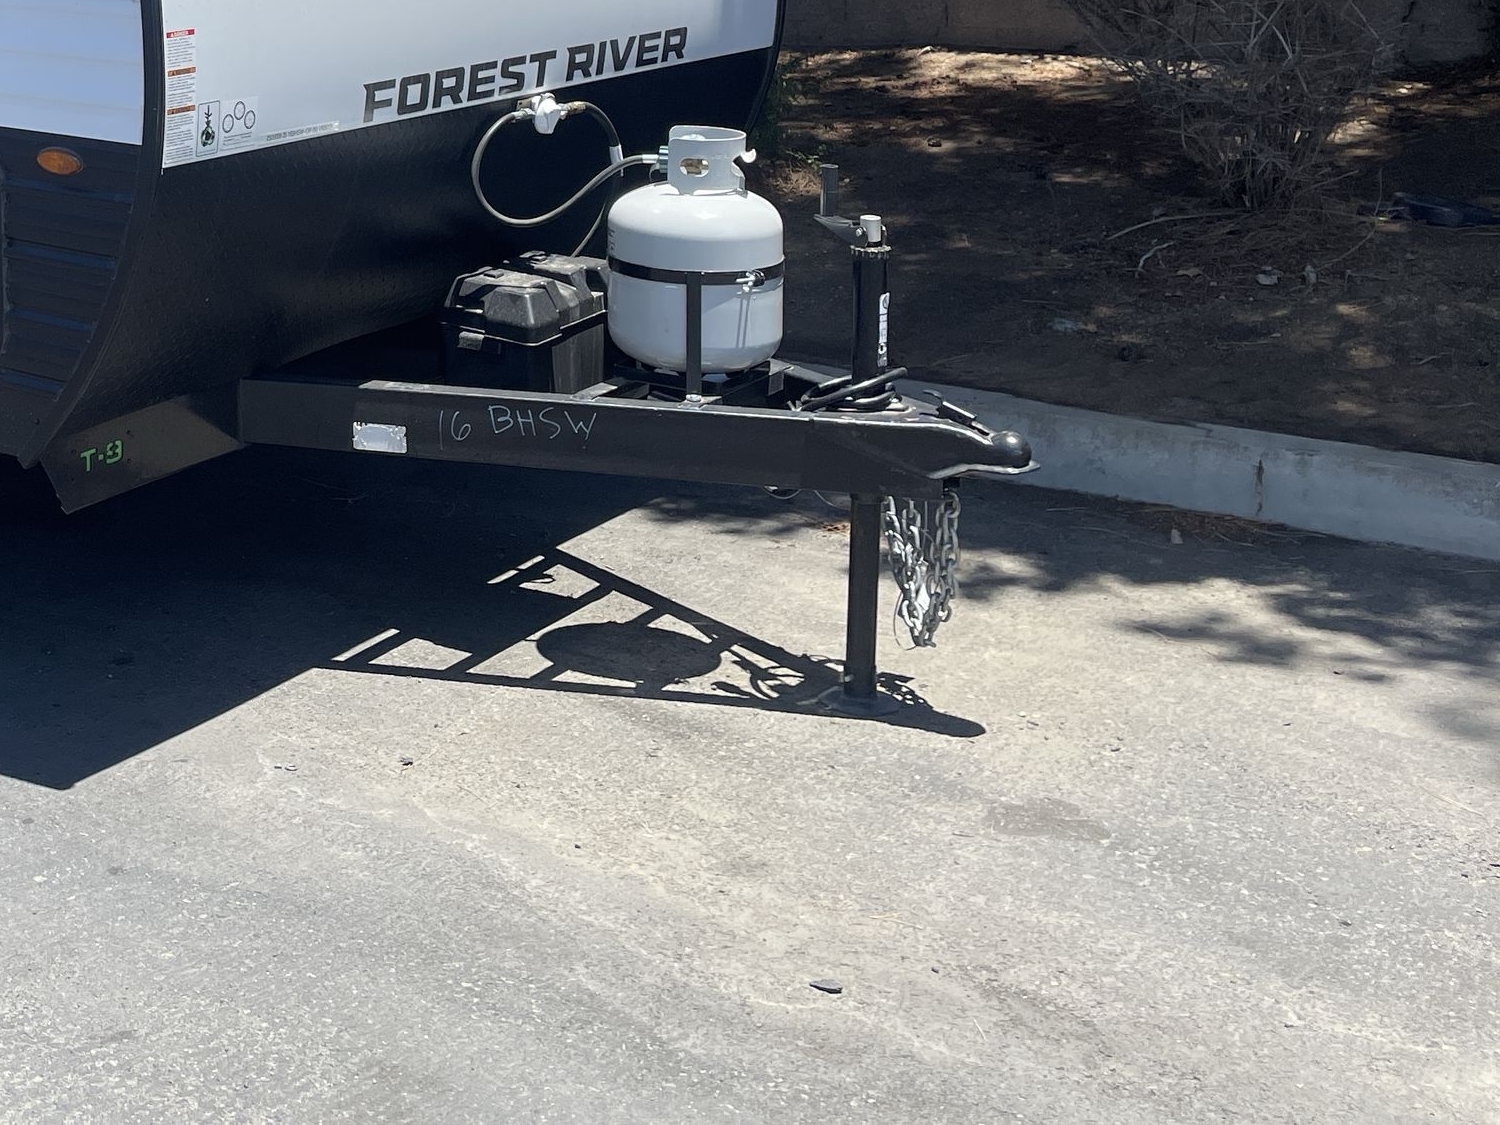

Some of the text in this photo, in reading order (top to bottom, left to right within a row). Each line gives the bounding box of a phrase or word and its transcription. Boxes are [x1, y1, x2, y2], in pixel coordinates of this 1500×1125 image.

[362, 26, 688, 124] FOREST RIVER
[439, 404, 597, 451] 16 BHSW
